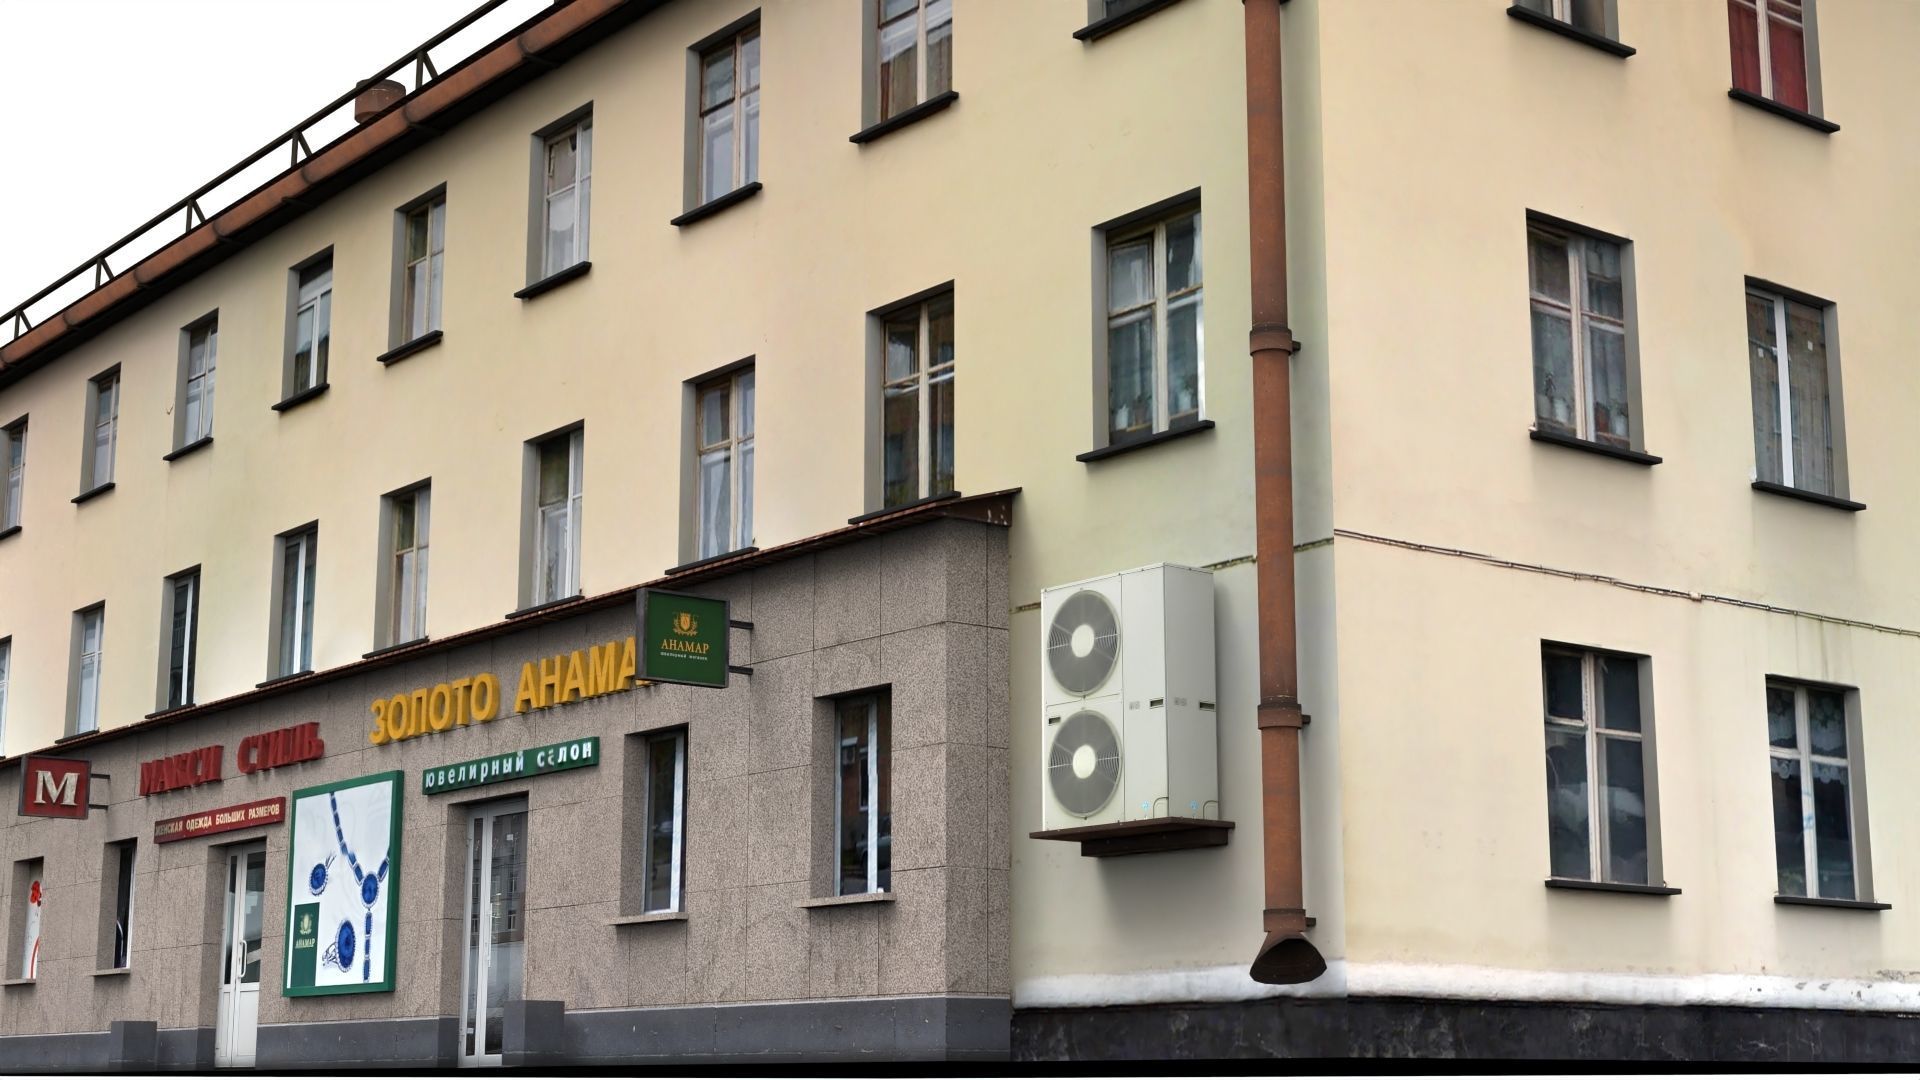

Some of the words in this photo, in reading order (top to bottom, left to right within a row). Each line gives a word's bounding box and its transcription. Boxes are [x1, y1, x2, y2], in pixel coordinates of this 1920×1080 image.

[661, 639, 710, 654] АНАМАР
[369, 672, 499, 745] ЗОЛОТО
[514, 636, 651, 713] АНАМА
[140, 745, 224, 796] МАКСИ
[237, 722, 325, 775] СТИЛЬ
[426, 751, 524, 788] ювелирный
[33, 770, 80, 806] М
[186, 815, 212, 831] ОДЕЖДА
[215, 809, 245, 826] БОЛЬШИХ
[248, 803, 280, 820] РАЗМЕРОВ
